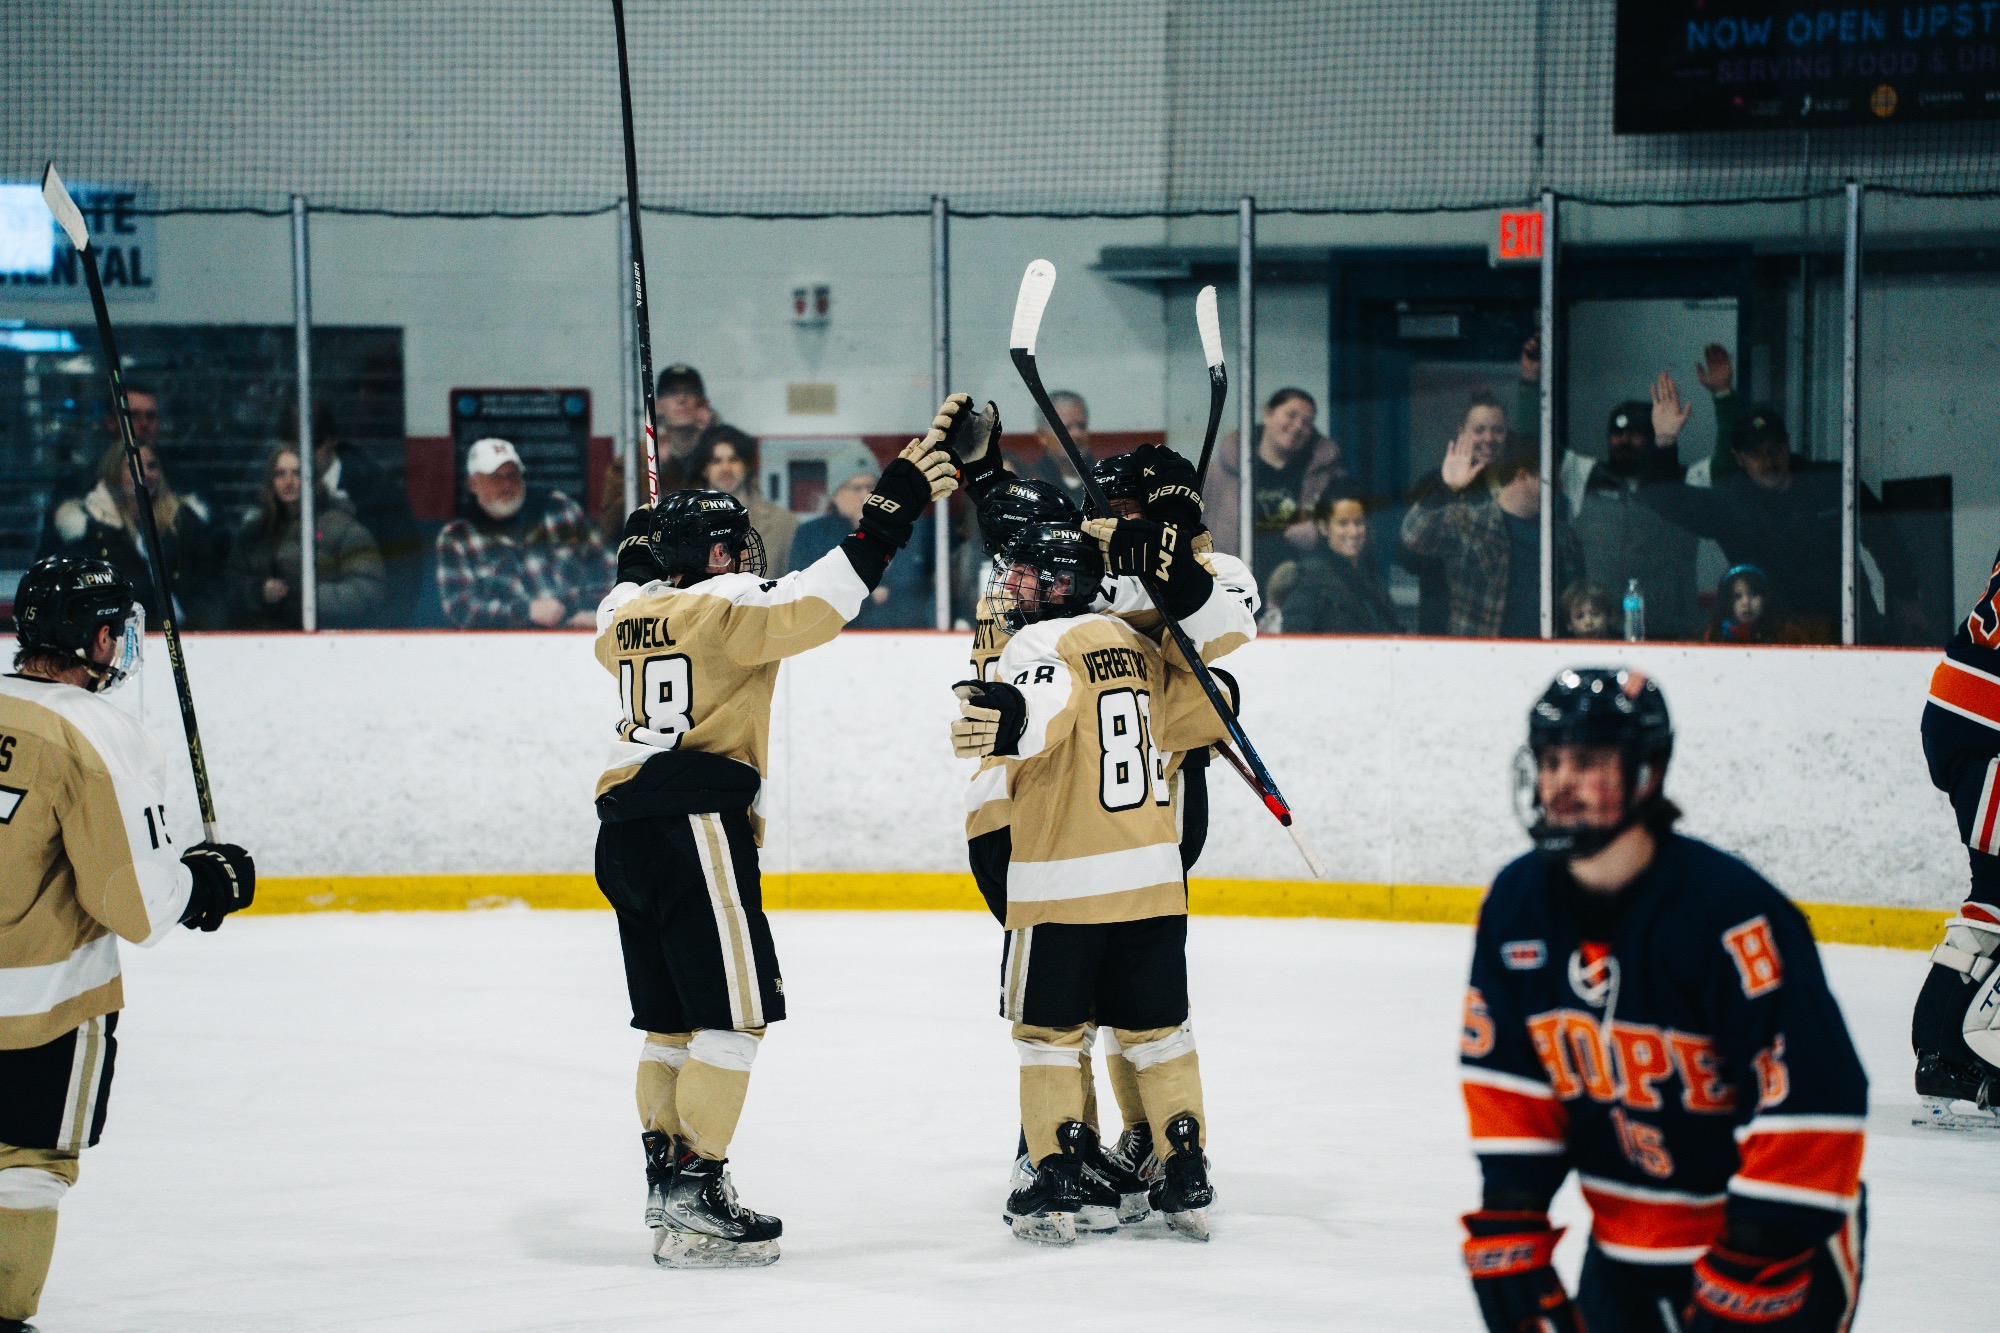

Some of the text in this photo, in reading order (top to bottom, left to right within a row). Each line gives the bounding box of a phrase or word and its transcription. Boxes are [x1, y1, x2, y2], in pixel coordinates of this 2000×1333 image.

[1686, 16, 1772, 50] NOW
[1786, 9, 1885, 46] OPEN
[1717, 55, 1833, 83] SERVING
[1841, 49, 1919, 79] FOOD
[1009, 485, 1039, 500] PNW
[701, 500, 728, 511] PNW
[651, 530, 662, 543] 48
[709, 528, 732, 537] CCM
[1052, 529, 1082, 541] PNW
[85, 572, 113, 585] PNW
[25, 606, 37, 620] 15
[96, 607, 119, 616] CCM
[616, 617, 676, 651] POWELL
[163, 618, 179, 671] TACKS
[1721, 914, 1783, 999] H
